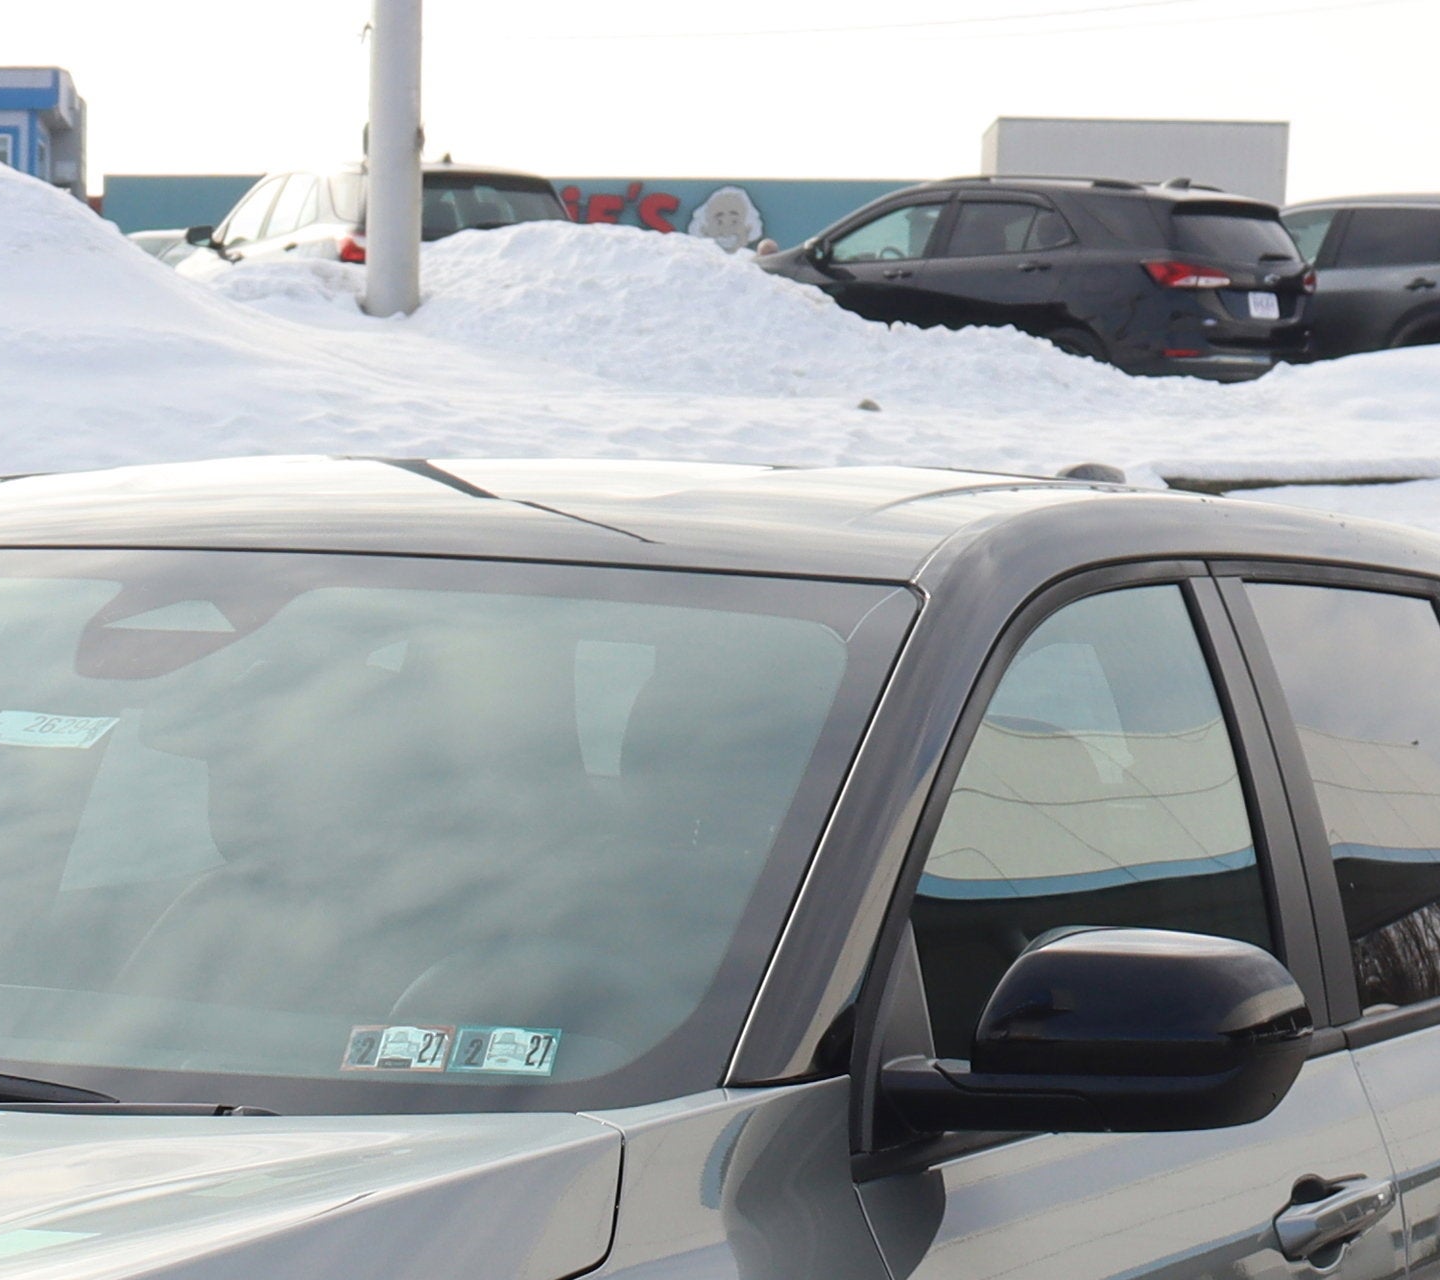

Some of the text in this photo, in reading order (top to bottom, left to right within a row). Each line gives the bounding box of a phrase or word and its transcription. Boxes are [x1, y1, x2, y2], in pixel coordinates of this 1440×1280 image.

[417, 1032, 447, 1066] 27
[464, 1034, 553, 1068] 2 27
